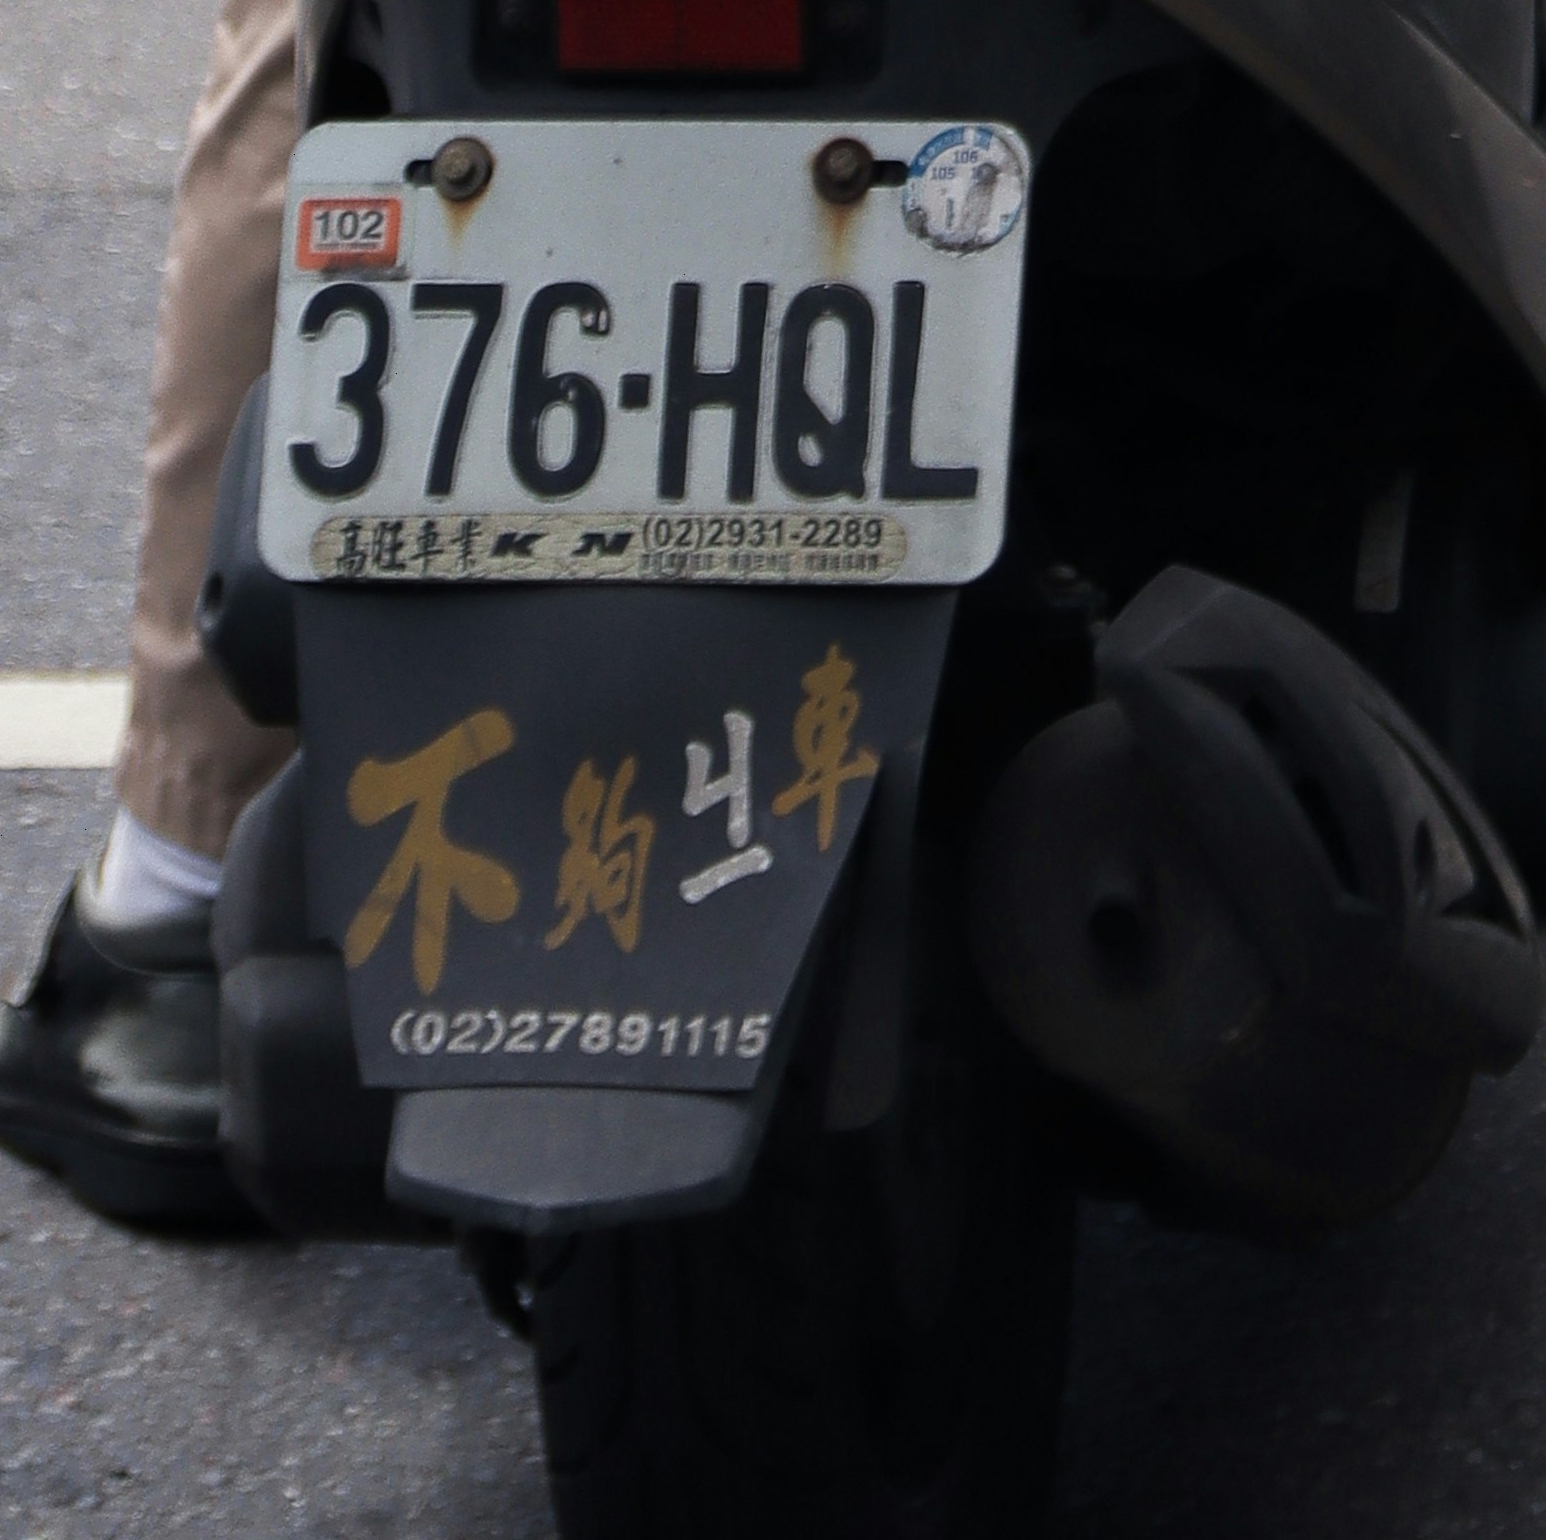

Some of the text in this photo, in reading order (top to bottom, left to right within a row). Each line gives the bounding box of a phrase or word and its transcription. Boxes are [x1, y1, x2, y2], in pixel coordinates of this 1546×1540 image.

[315, 210, 384, 240] 102
[641, 516, 883, 550] (02)2931-2289
[389, 1009, 772, 1060] (02)27891115
